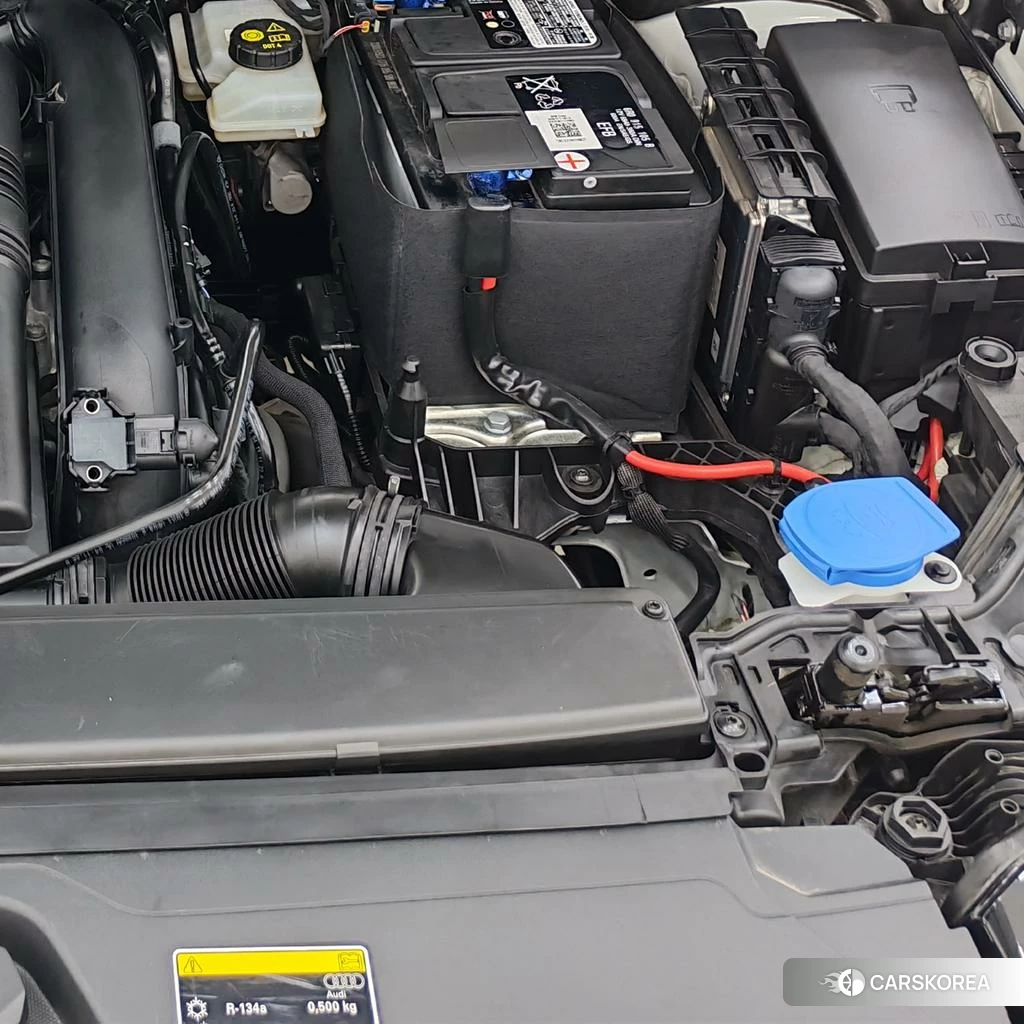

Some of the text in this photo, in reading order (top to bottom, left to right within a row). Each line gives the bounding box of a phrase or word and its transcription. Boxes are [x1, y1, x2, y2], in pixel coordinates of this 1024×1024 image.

[596, 121, 617, 137] EFB
[326, 990, 347, 999] Audi
[225, 1000, 358, 1015] R-134a 0,500 kg
